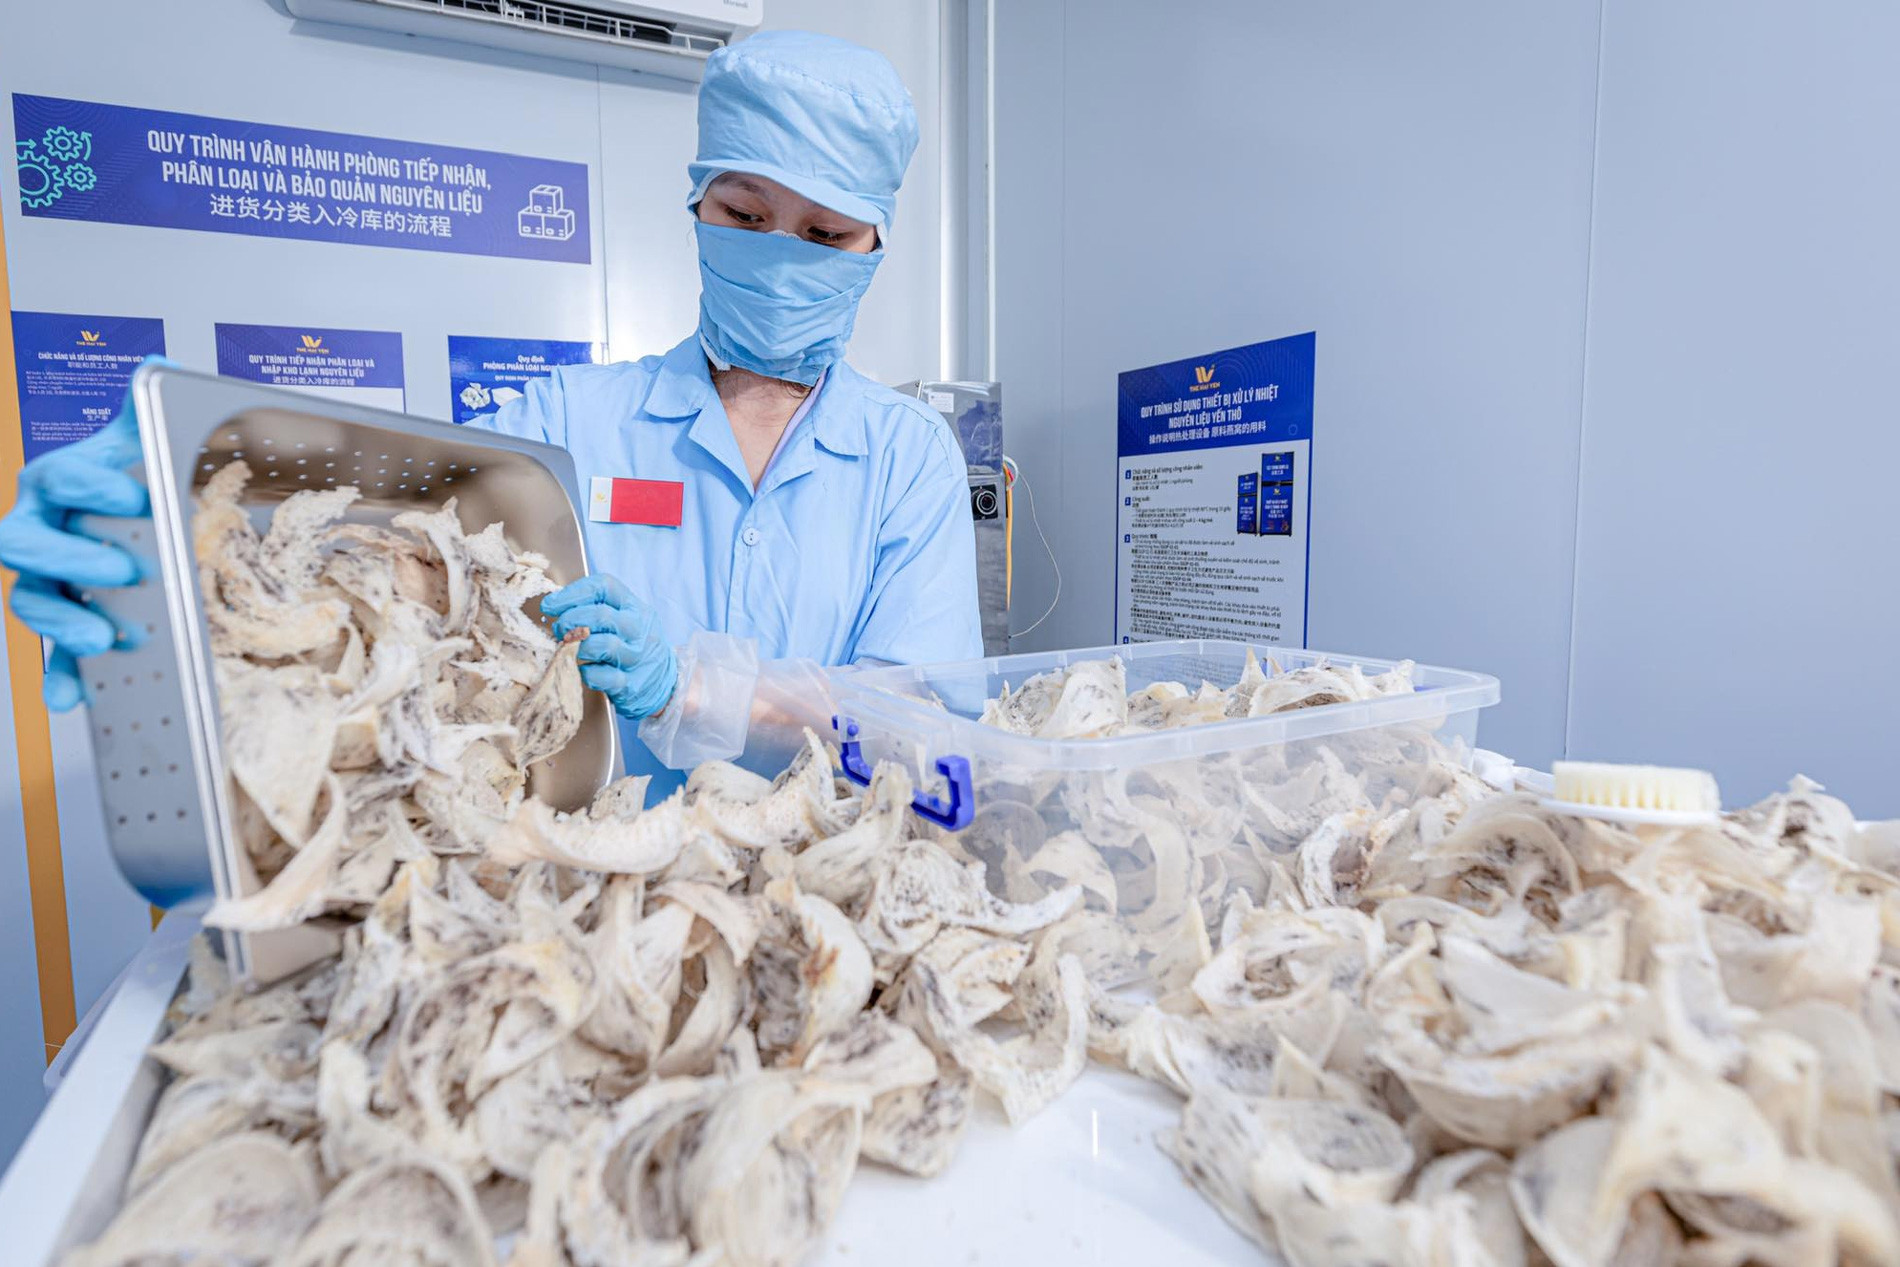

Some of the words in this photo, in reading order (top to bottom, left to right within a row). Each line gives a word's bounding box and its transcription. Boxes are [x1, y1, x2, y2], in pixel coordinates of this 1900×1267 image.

[147, 130, 185, 154] QUY
[189, 133, 246, 162] TRÌNH
[250, 139, 287, 168] VẬN
[291, 144, 340, 173] HÀNH
[344, 151, 400, 179] PHÒNG
[403, 157, 439, 183] TIẾP
[443, 164, 491, 191] NHẬN,
[162, 160, 213, 187] PHÂN
[218, 167, 259, 194] LOẠI
[262, 169, 287, 194] VÀ
[291, 170, 327, 198] BẢO
[330, 176, 376, 203] QUẢN
[381, 185, 445, 211] NGUYÊN
[449, 189, 483, 216] LIỆU
[210, 194, 453, 238] 进货分类入冷库的流程
[248, 354, 263, 364] QUY
[265, 354, 288, 365] TRÌNH
[288, 354, 305, 365] TIẾP
[365, 357, 375, 368] VÀ
[283, 366, 298, 375] KHO
[1140, 405, 1154, 418] QUY
[1154, 402, 1173, 417] TRÌNH
[1202, 392, 1222, 408] THIẾT
[1223, 395, 1231, 408] BỊ
[1244, 386, 1254, 403] LÝ
[1255, 383, 1279, 402] NHIỆT
